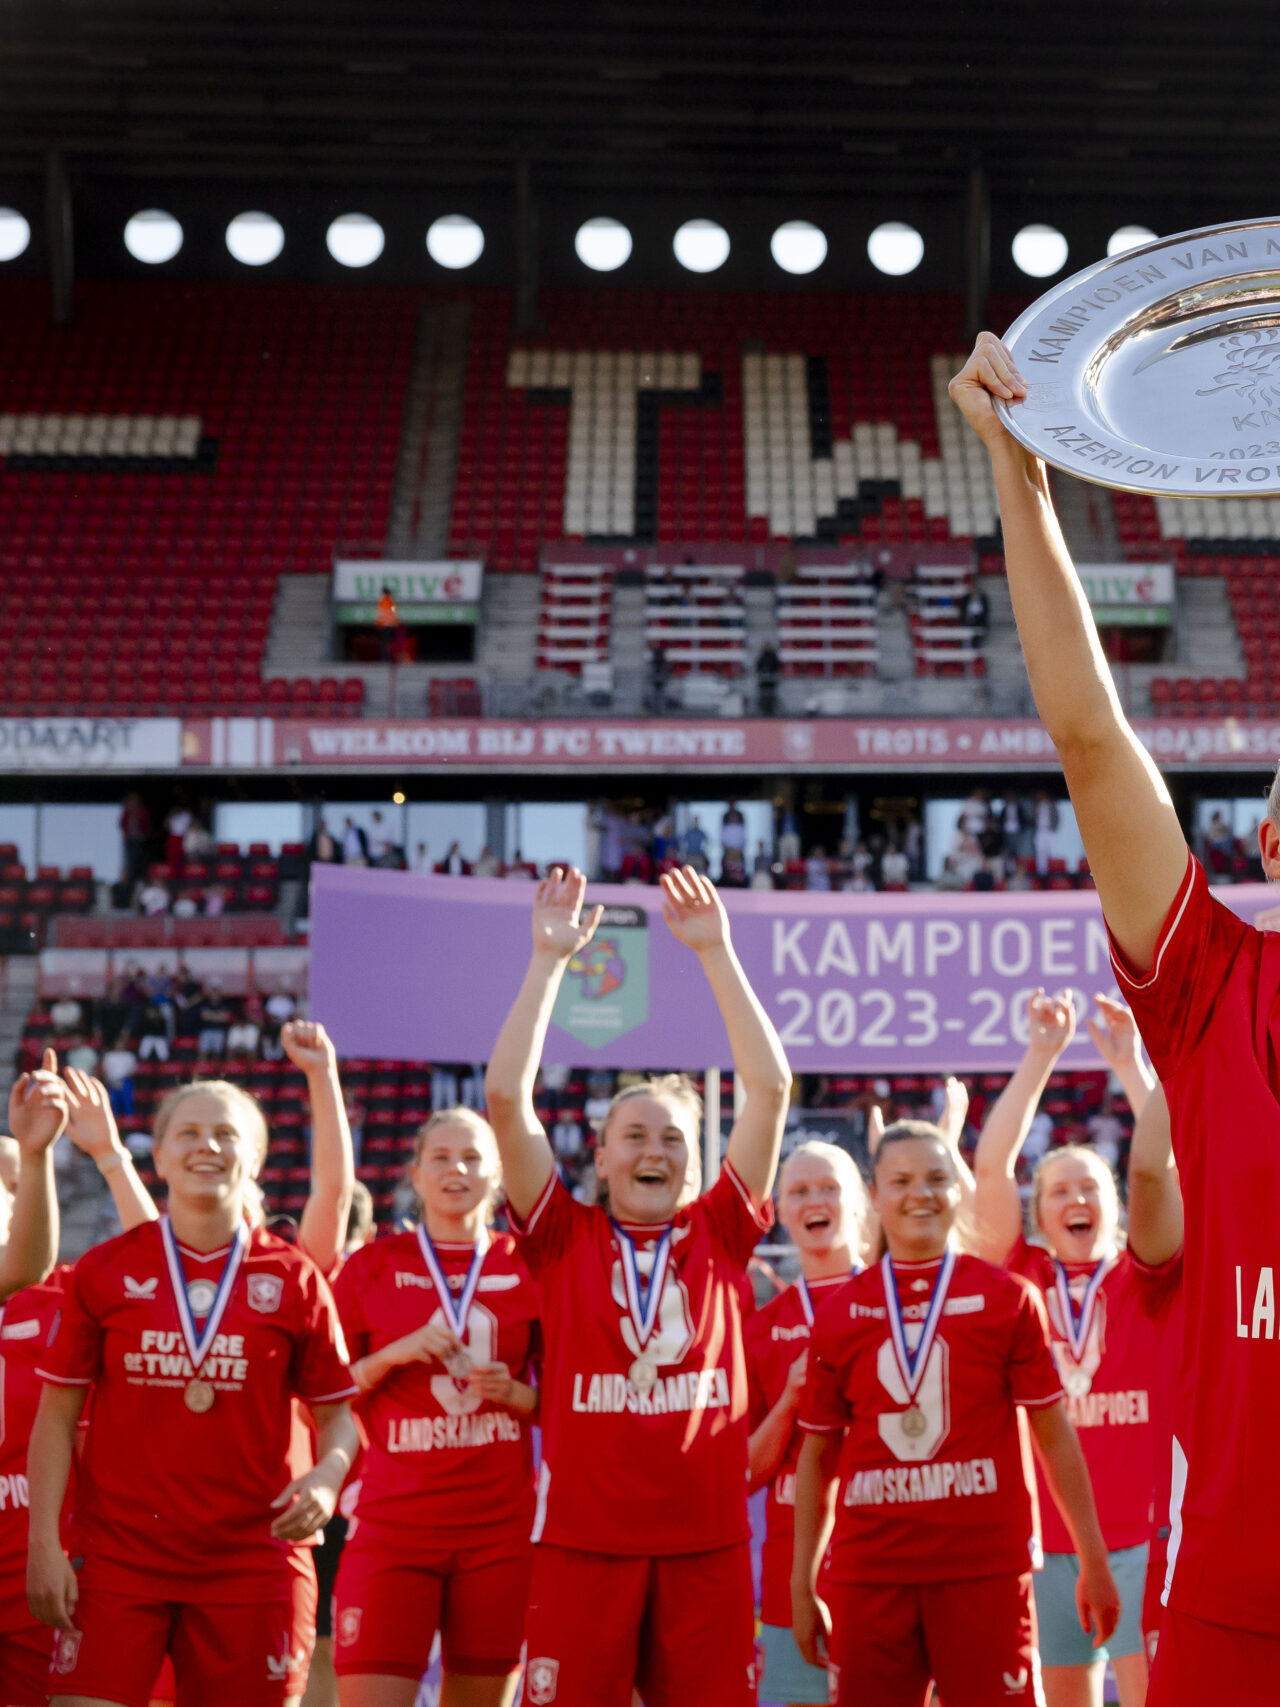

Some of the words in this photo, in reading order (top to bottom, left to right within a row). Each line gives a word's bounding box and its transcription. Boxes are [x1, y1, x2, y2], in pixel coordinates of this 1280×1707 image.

[1028, 264, 1167, 363] KAMPIOEN
[1170, 241, 1249, 270] VAN
[1044, 426, 1180, 480] AZERION
[309, 728, 470, 757] WELKOM
[478, 728, 536, 757] BIJ
[544, 728, 590, 757] FC
[597, 728, 746, 757] TWENTE
[855, 728, 950, 756] TROTS
[141, 1329, 245, 1357] FUTRE
[144, 1353, 249, 1381] TWNTE
